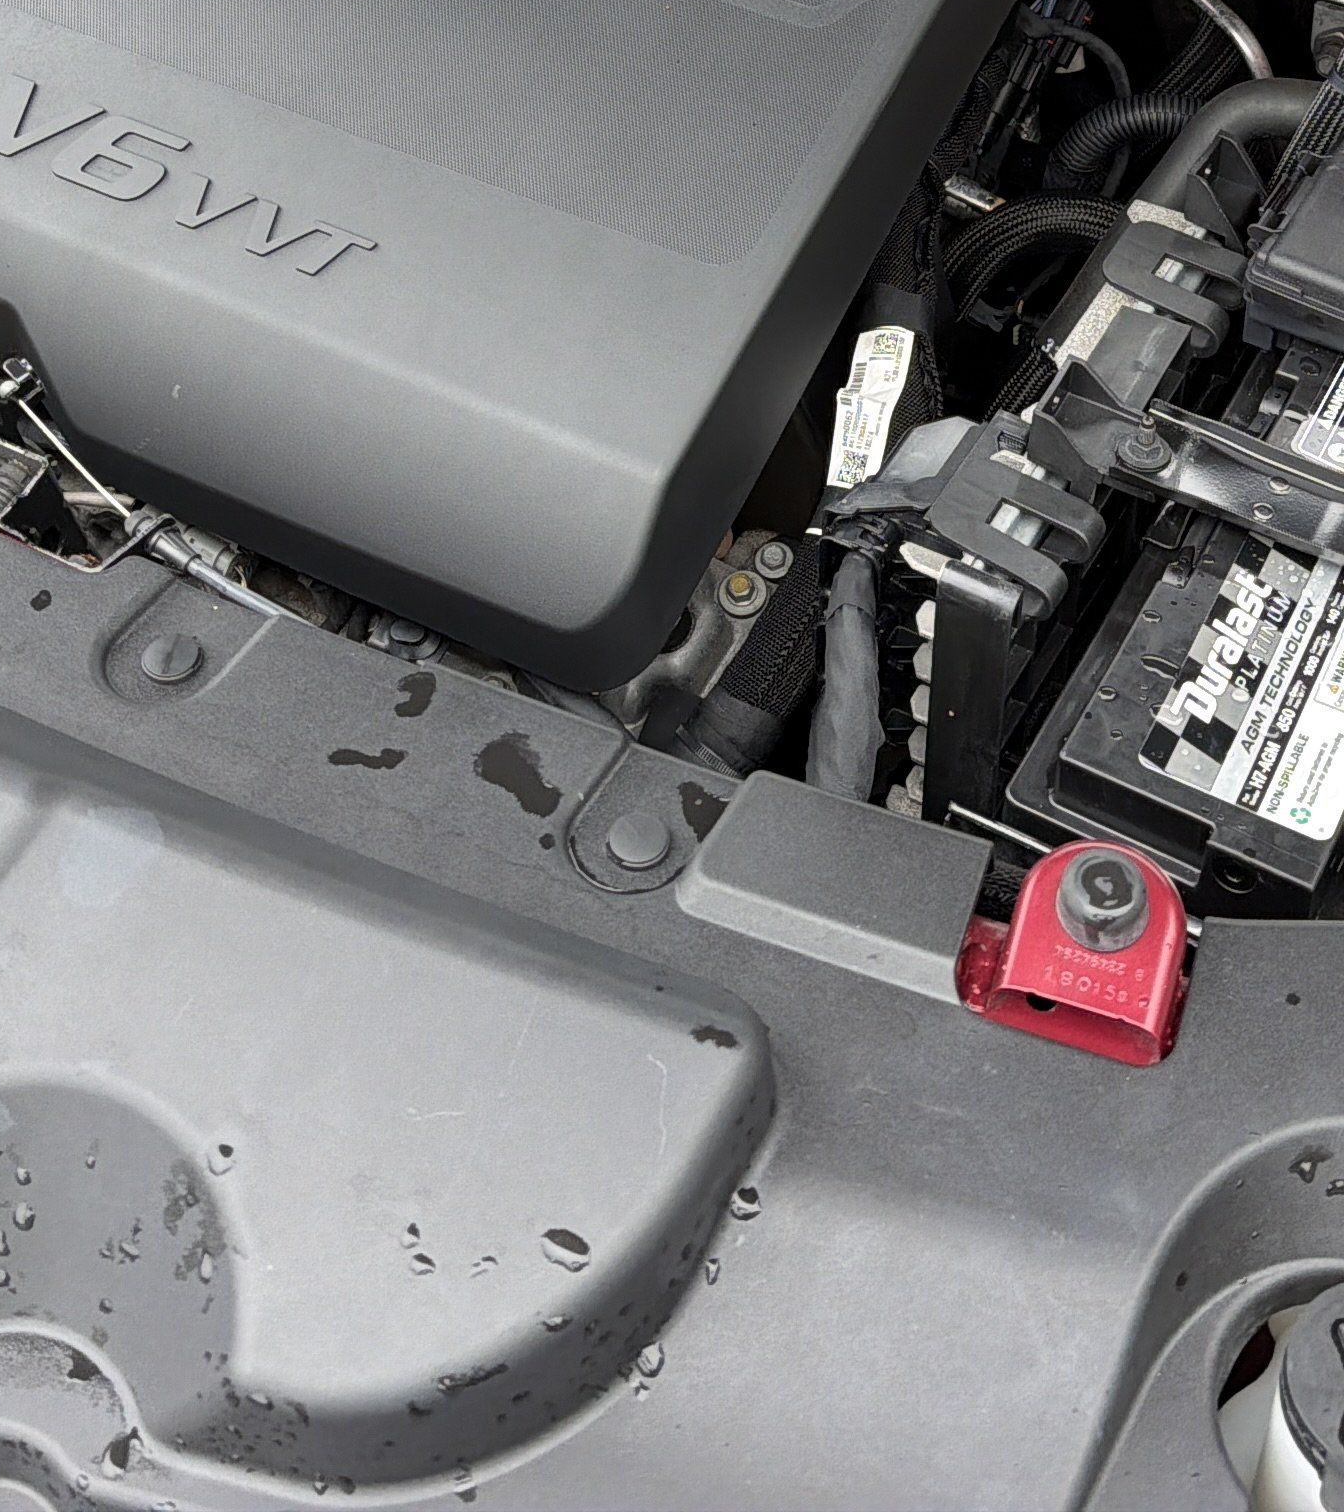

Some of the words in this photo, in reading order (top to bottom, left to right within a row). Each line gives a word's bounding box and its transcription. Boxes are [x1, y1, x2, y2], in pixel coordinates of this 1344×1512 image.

[1170, 565, 1274, 729] Duralast
[1233, 589, 1293, 692] PLATINUM
[1238, 710, 1267, 754] AGM
[1259, 596, 1318, 708] TECHNOLOGY
[1248, 740, 1281, 790] H7-AGM
[1265, 732, 1309, 814] NON-SPILLABLE
